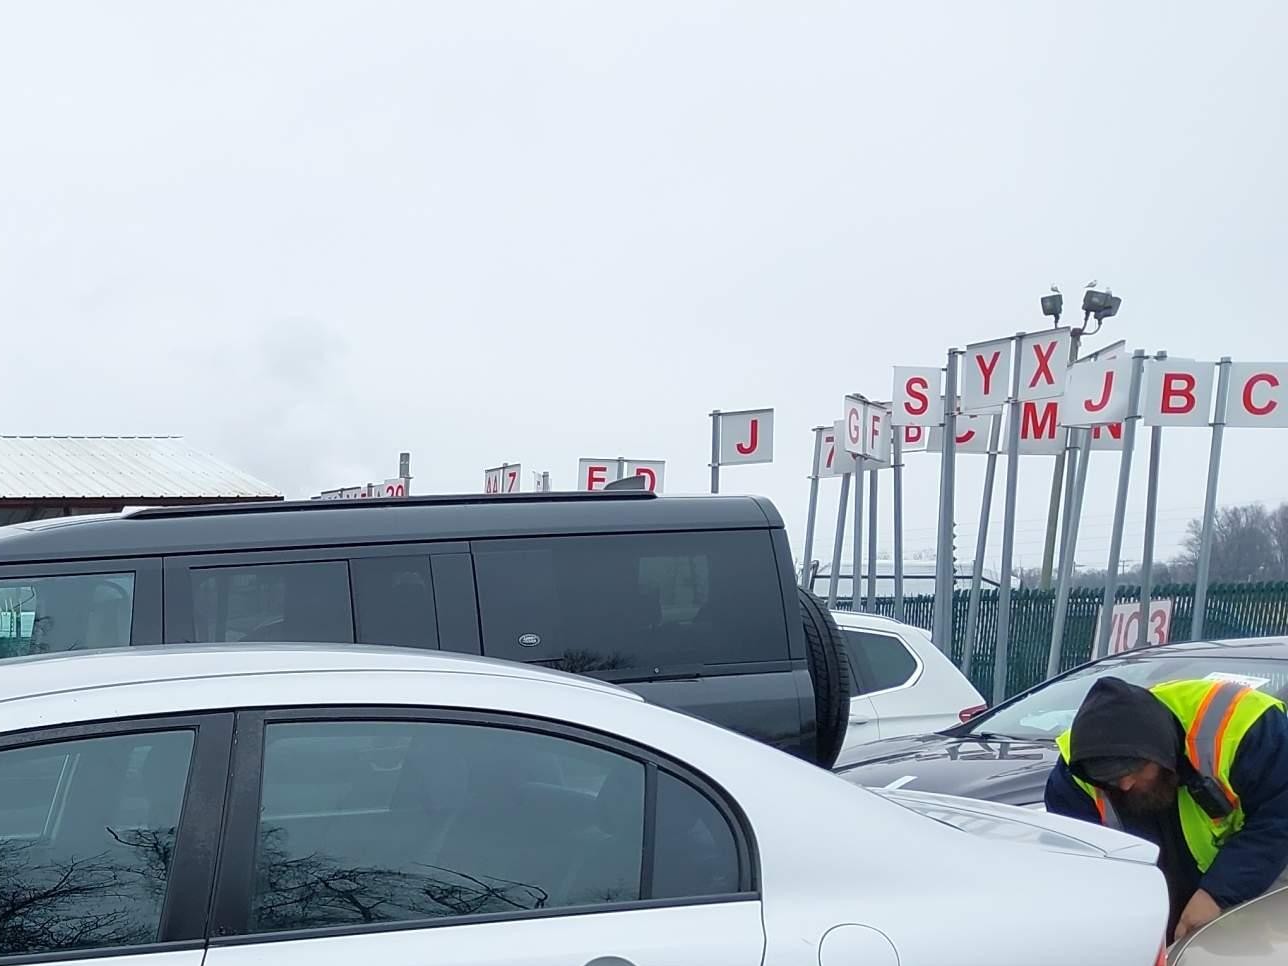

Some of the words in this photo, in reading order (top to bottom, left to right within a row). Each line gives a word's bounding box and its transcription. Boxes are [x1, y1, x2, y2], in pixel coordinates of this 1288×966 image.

[975, 351, 1001, 396] Y
[1028, 340, 1058, 388] X
[903, 377, 929, 416] S
[1083, 371, 1115, 412] J
[1160, 373, 1196, 414] B
[1242, 373, 1280, 415] C
[736, 419, 759, 455] J
[848, 407, 860, 444] G
[871, 415, 881, 449] F
[1020, 402, 1058, 440] M
